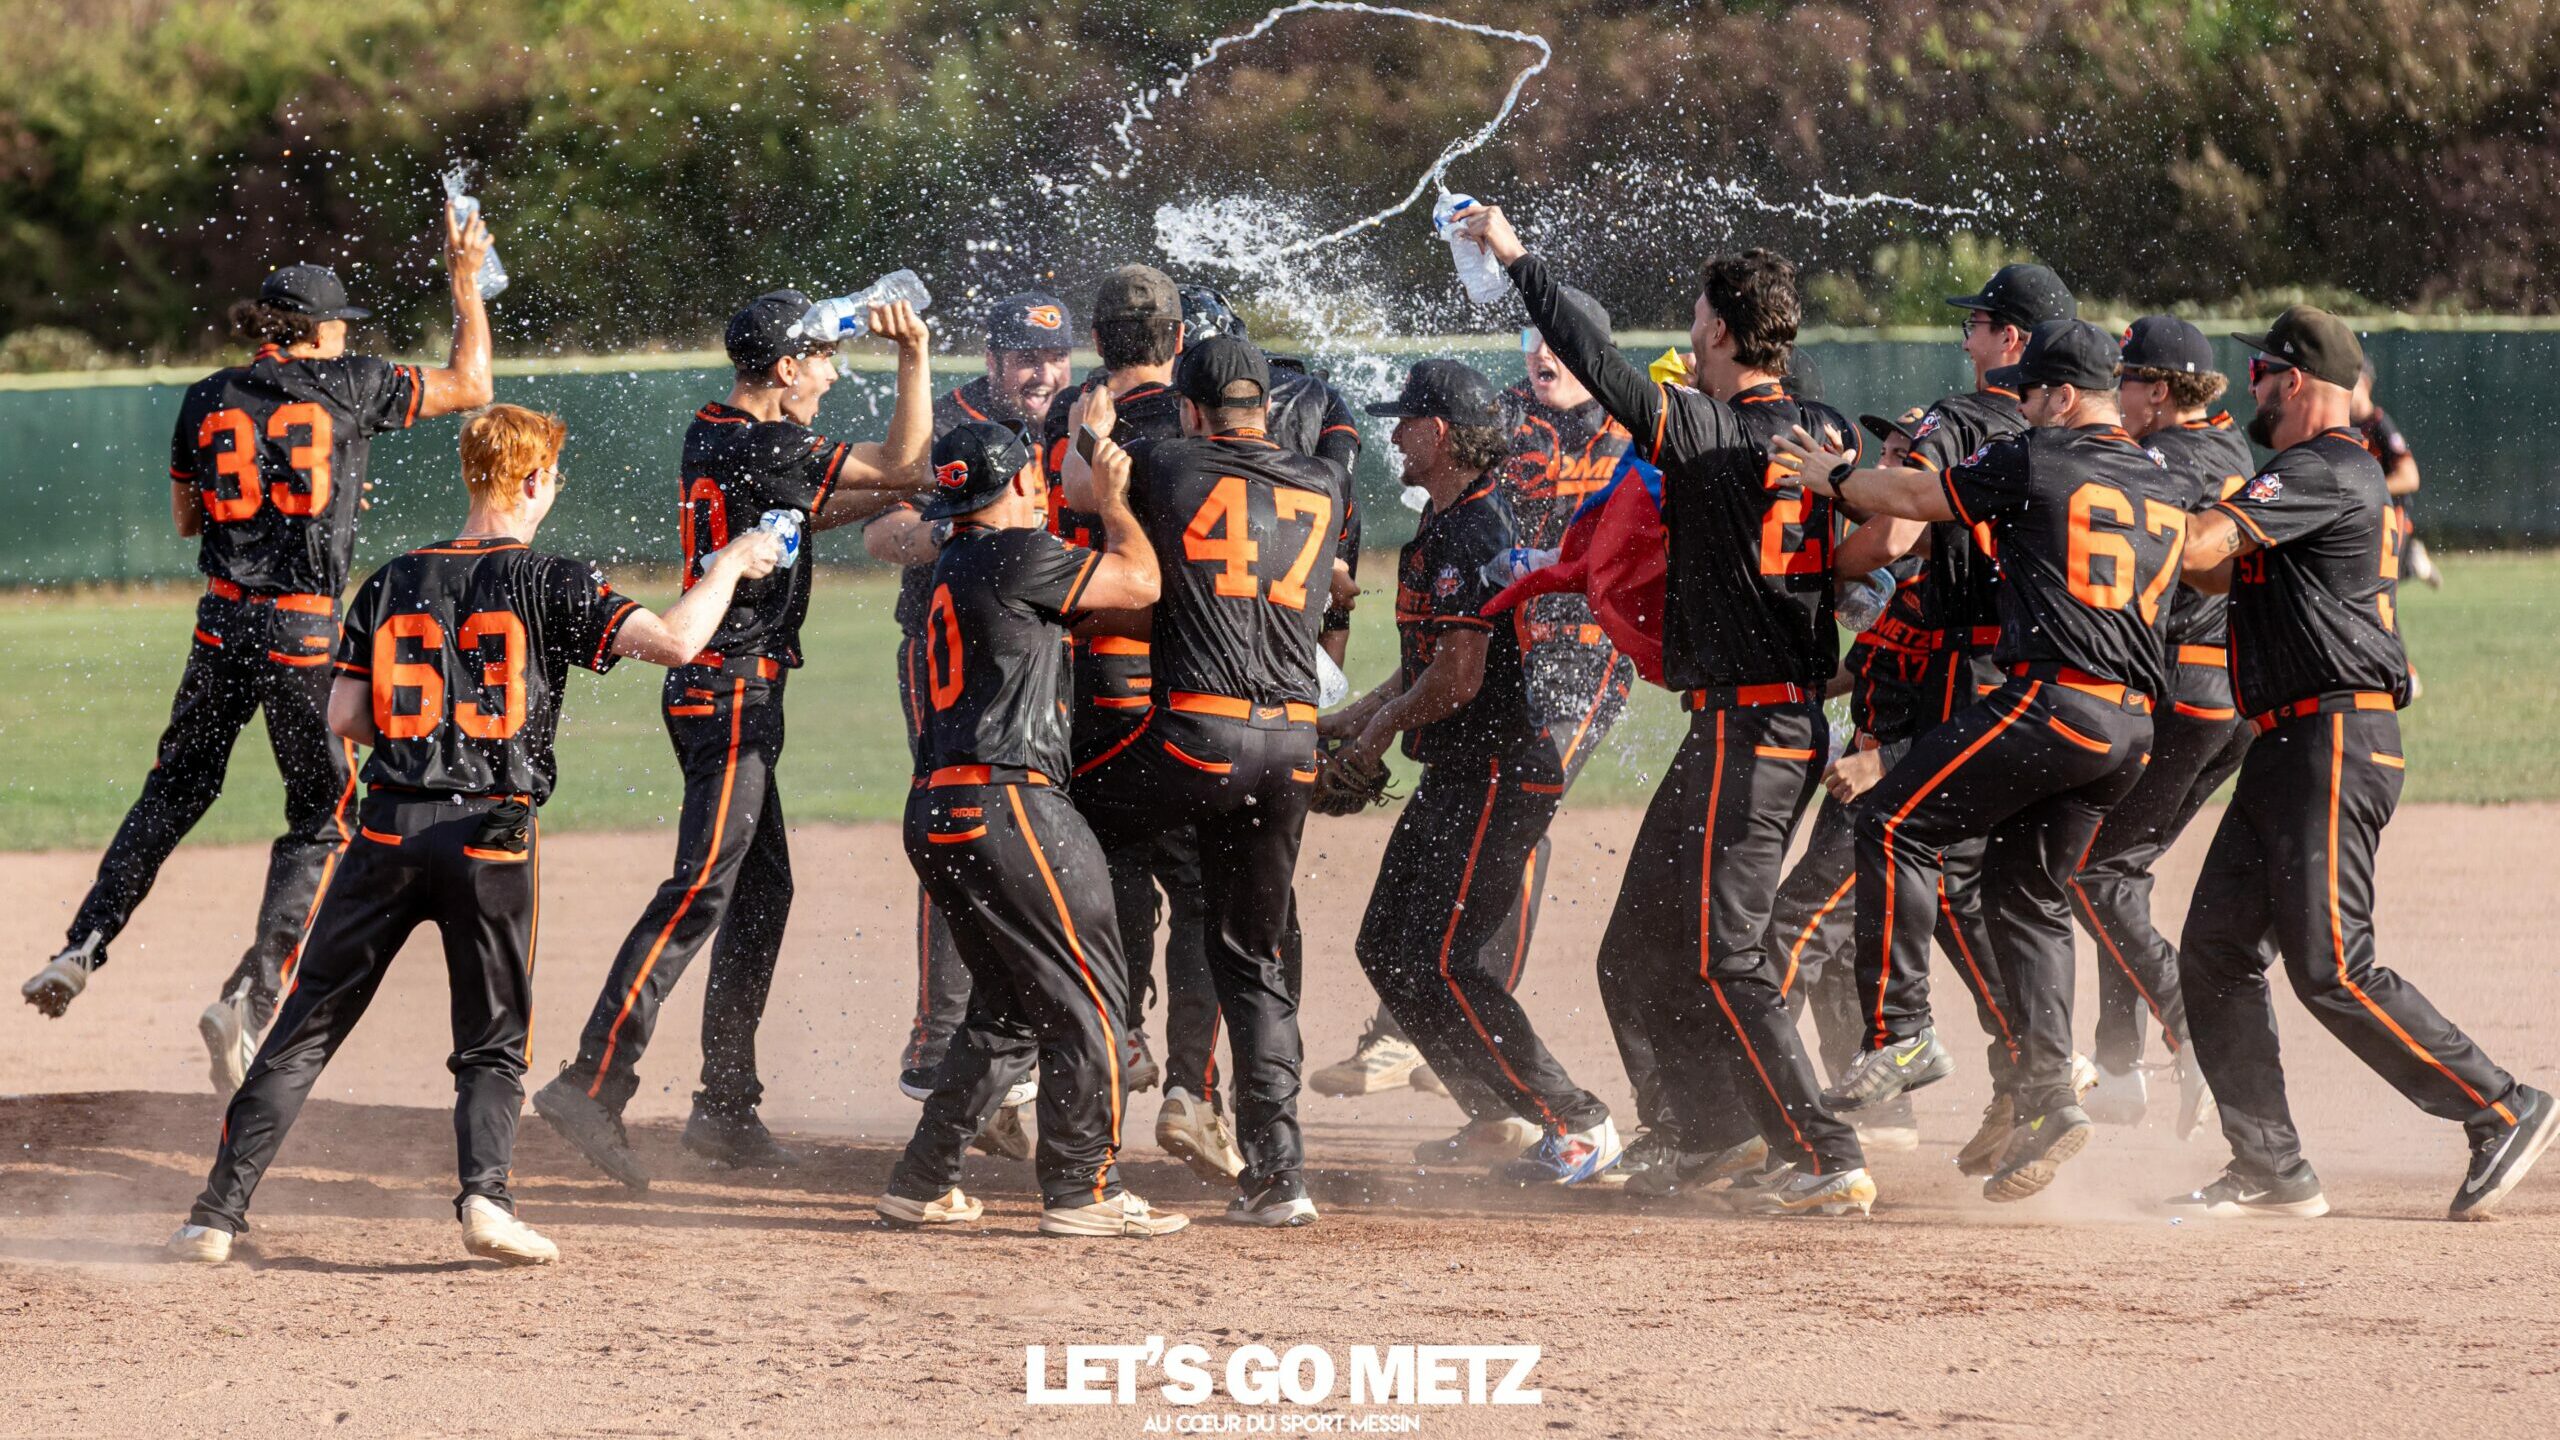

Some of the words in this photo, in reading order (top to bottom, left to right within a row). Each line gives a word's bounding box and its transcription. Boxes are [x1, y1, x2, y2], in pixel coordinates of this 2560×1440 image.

[198, 403, 333, 522] 33
[1182, 476, 1332, 611] 47
[2067, 482, 2188, 628] 67
[2240, 550, 2267, 584] 51
[372, 610, 527, 739] 63
[1898, 652, 1929, 683] 17
